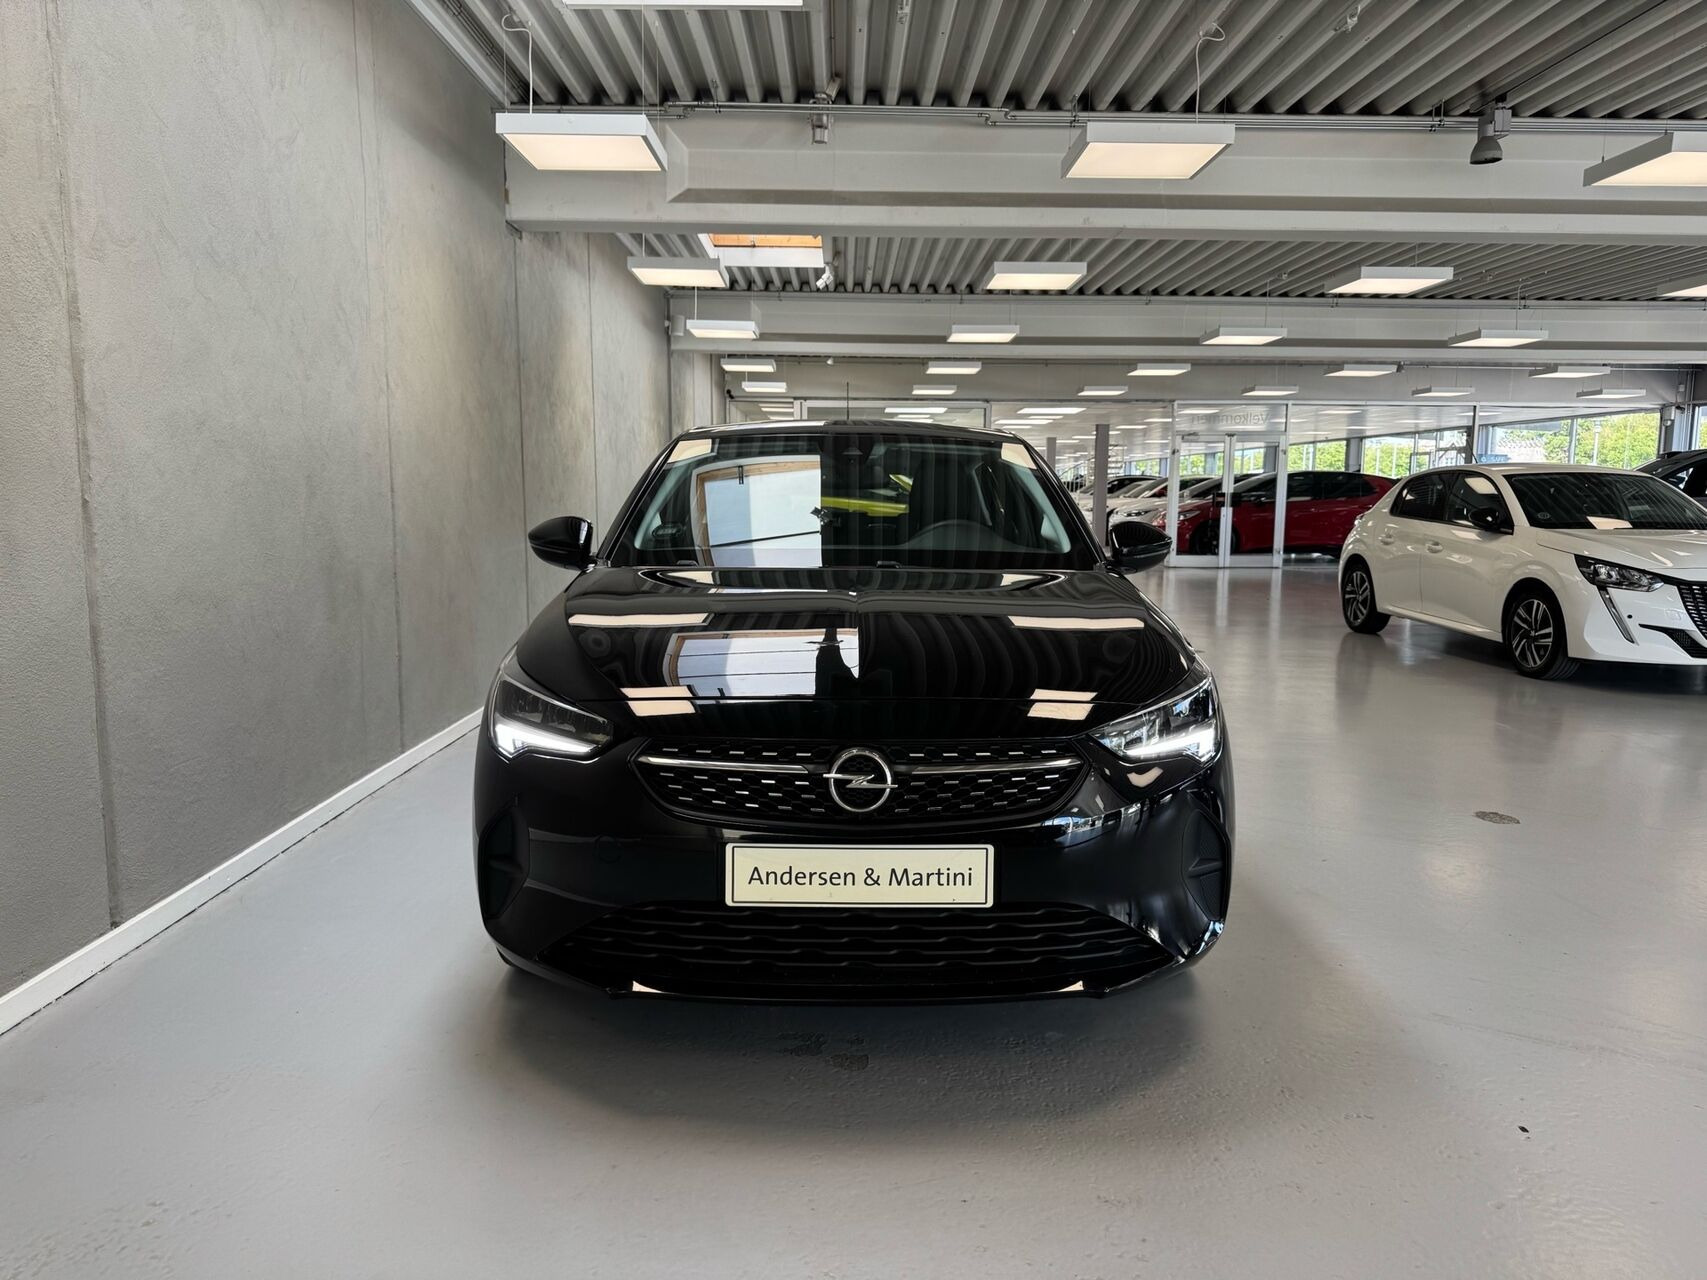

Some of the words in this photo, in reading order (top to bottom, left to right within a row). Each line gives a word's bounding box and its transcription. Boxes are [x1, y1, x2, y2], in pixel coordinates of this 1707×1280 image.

[748, 866, 855, 886] Andersen
[863, 867, 881, 887] &
[888, 867, 973, 887] Martini
